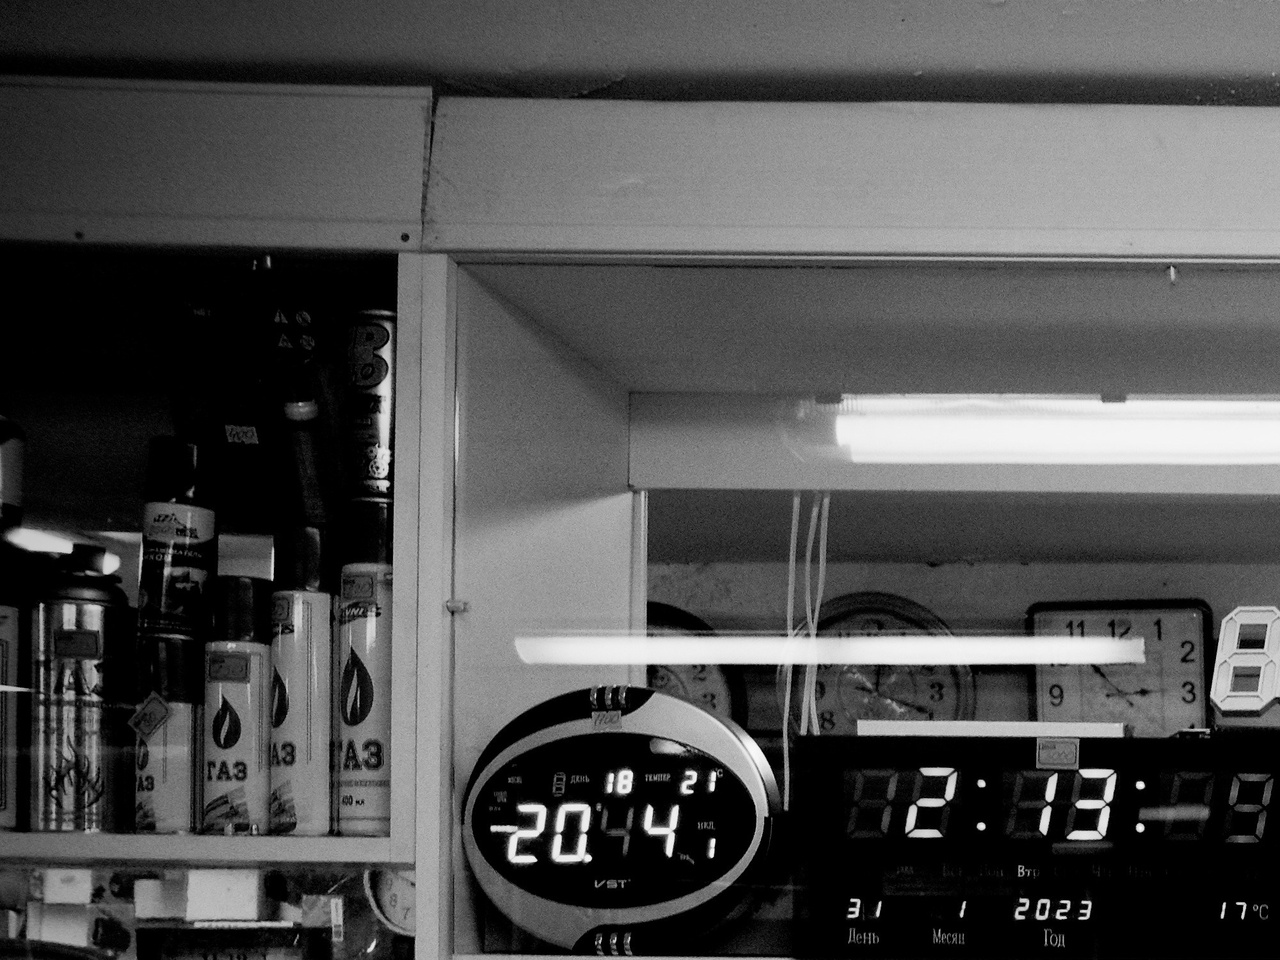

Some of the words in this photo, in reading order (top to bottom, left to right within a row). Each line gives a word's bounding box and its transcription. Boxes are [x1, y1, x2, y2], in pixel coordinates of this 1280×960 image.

[1154, 618, 1162, 640] 1
[1180, 641, 1195, 663] 2
[1049, 684, 1064, 707] 9
[1182, 682, 1197, 704] 3
[207, 760, 248, 781] ГАЗ
[605, 770, 634, 794] 18
[847, 898, 882, 920] 31
[960, 900, 967, 918] 1
[1014, 898, 1092, 921] 2023
[847, 929, 880, 946] День
[933, 930, 966, 945] Месяц
[1043, 929, 1066, 947] Год
